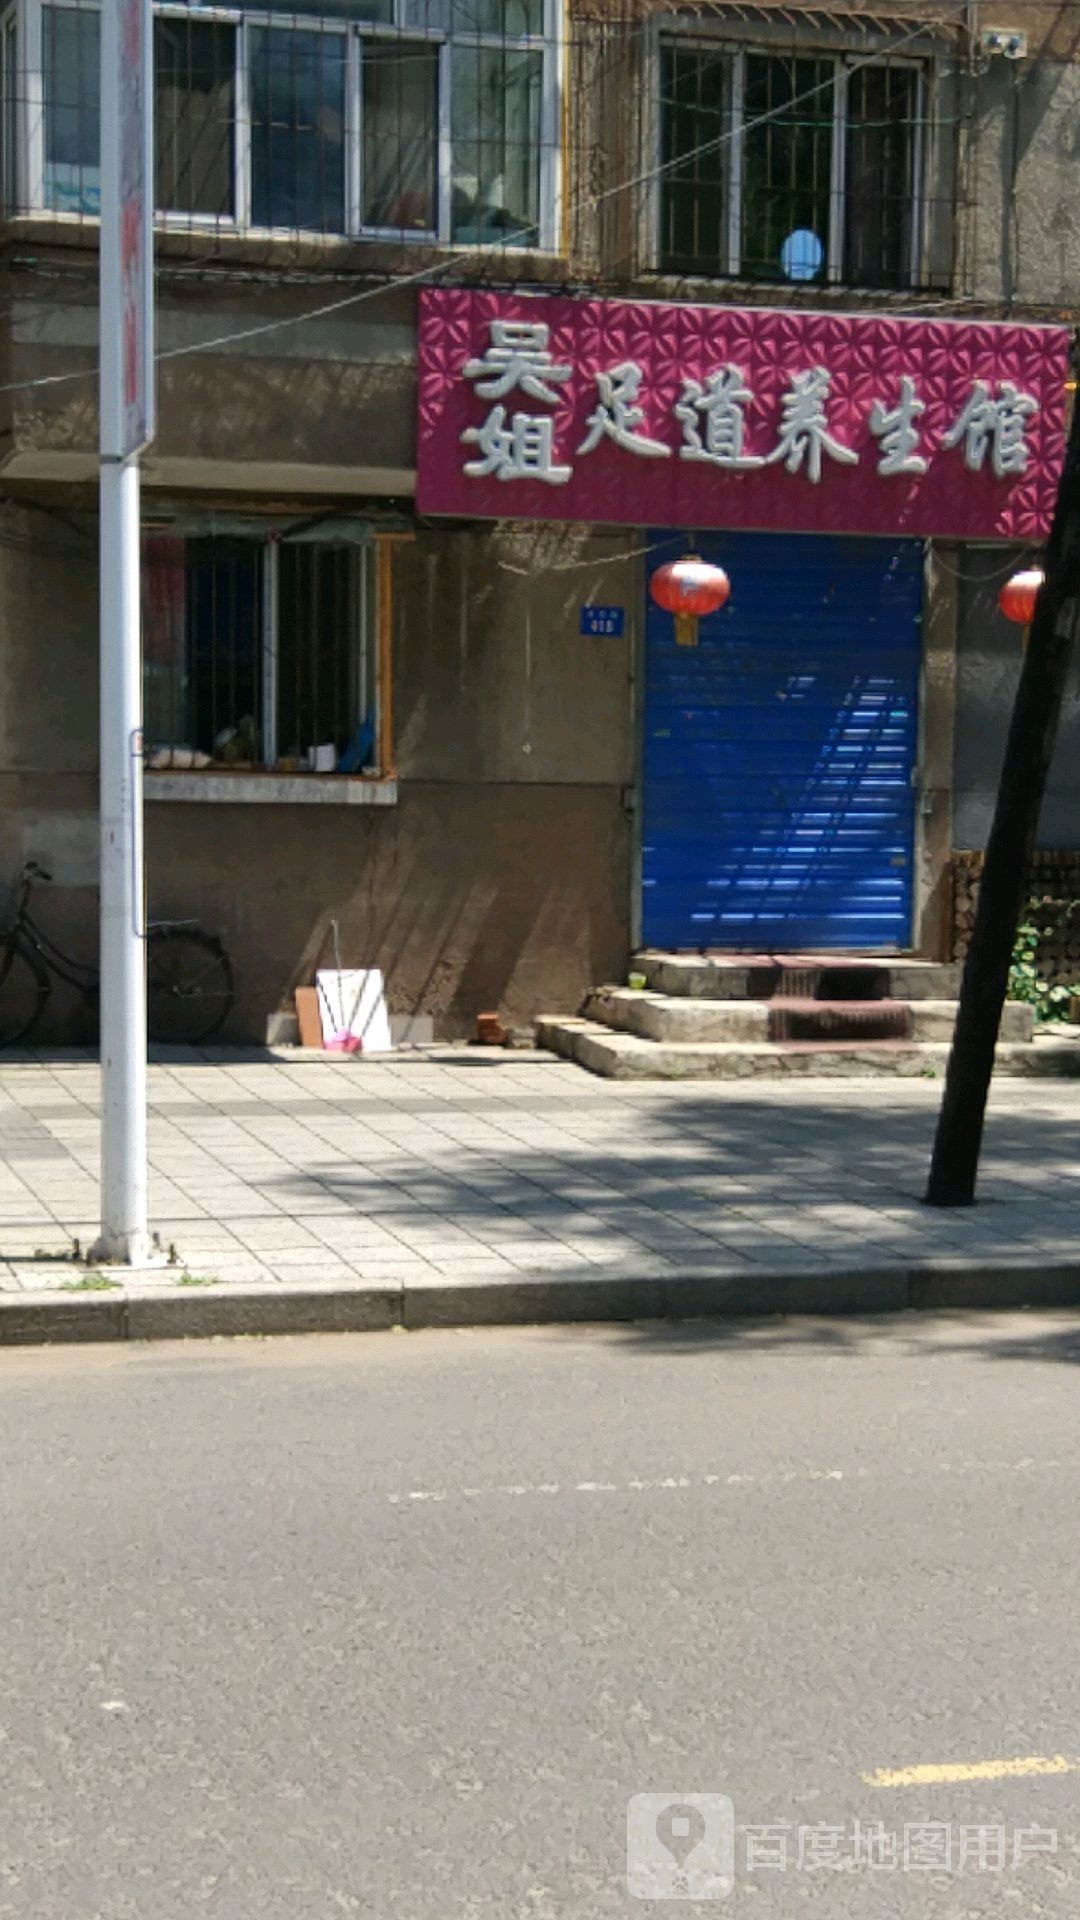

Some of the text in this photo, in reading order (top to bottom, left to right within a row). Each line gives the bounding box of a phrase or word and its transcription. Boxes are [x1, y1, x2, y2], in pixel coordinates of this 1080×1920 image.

[462, 319, 574, 485] 吴姐
[576, 360, 1039, 484] 足道养生馆
